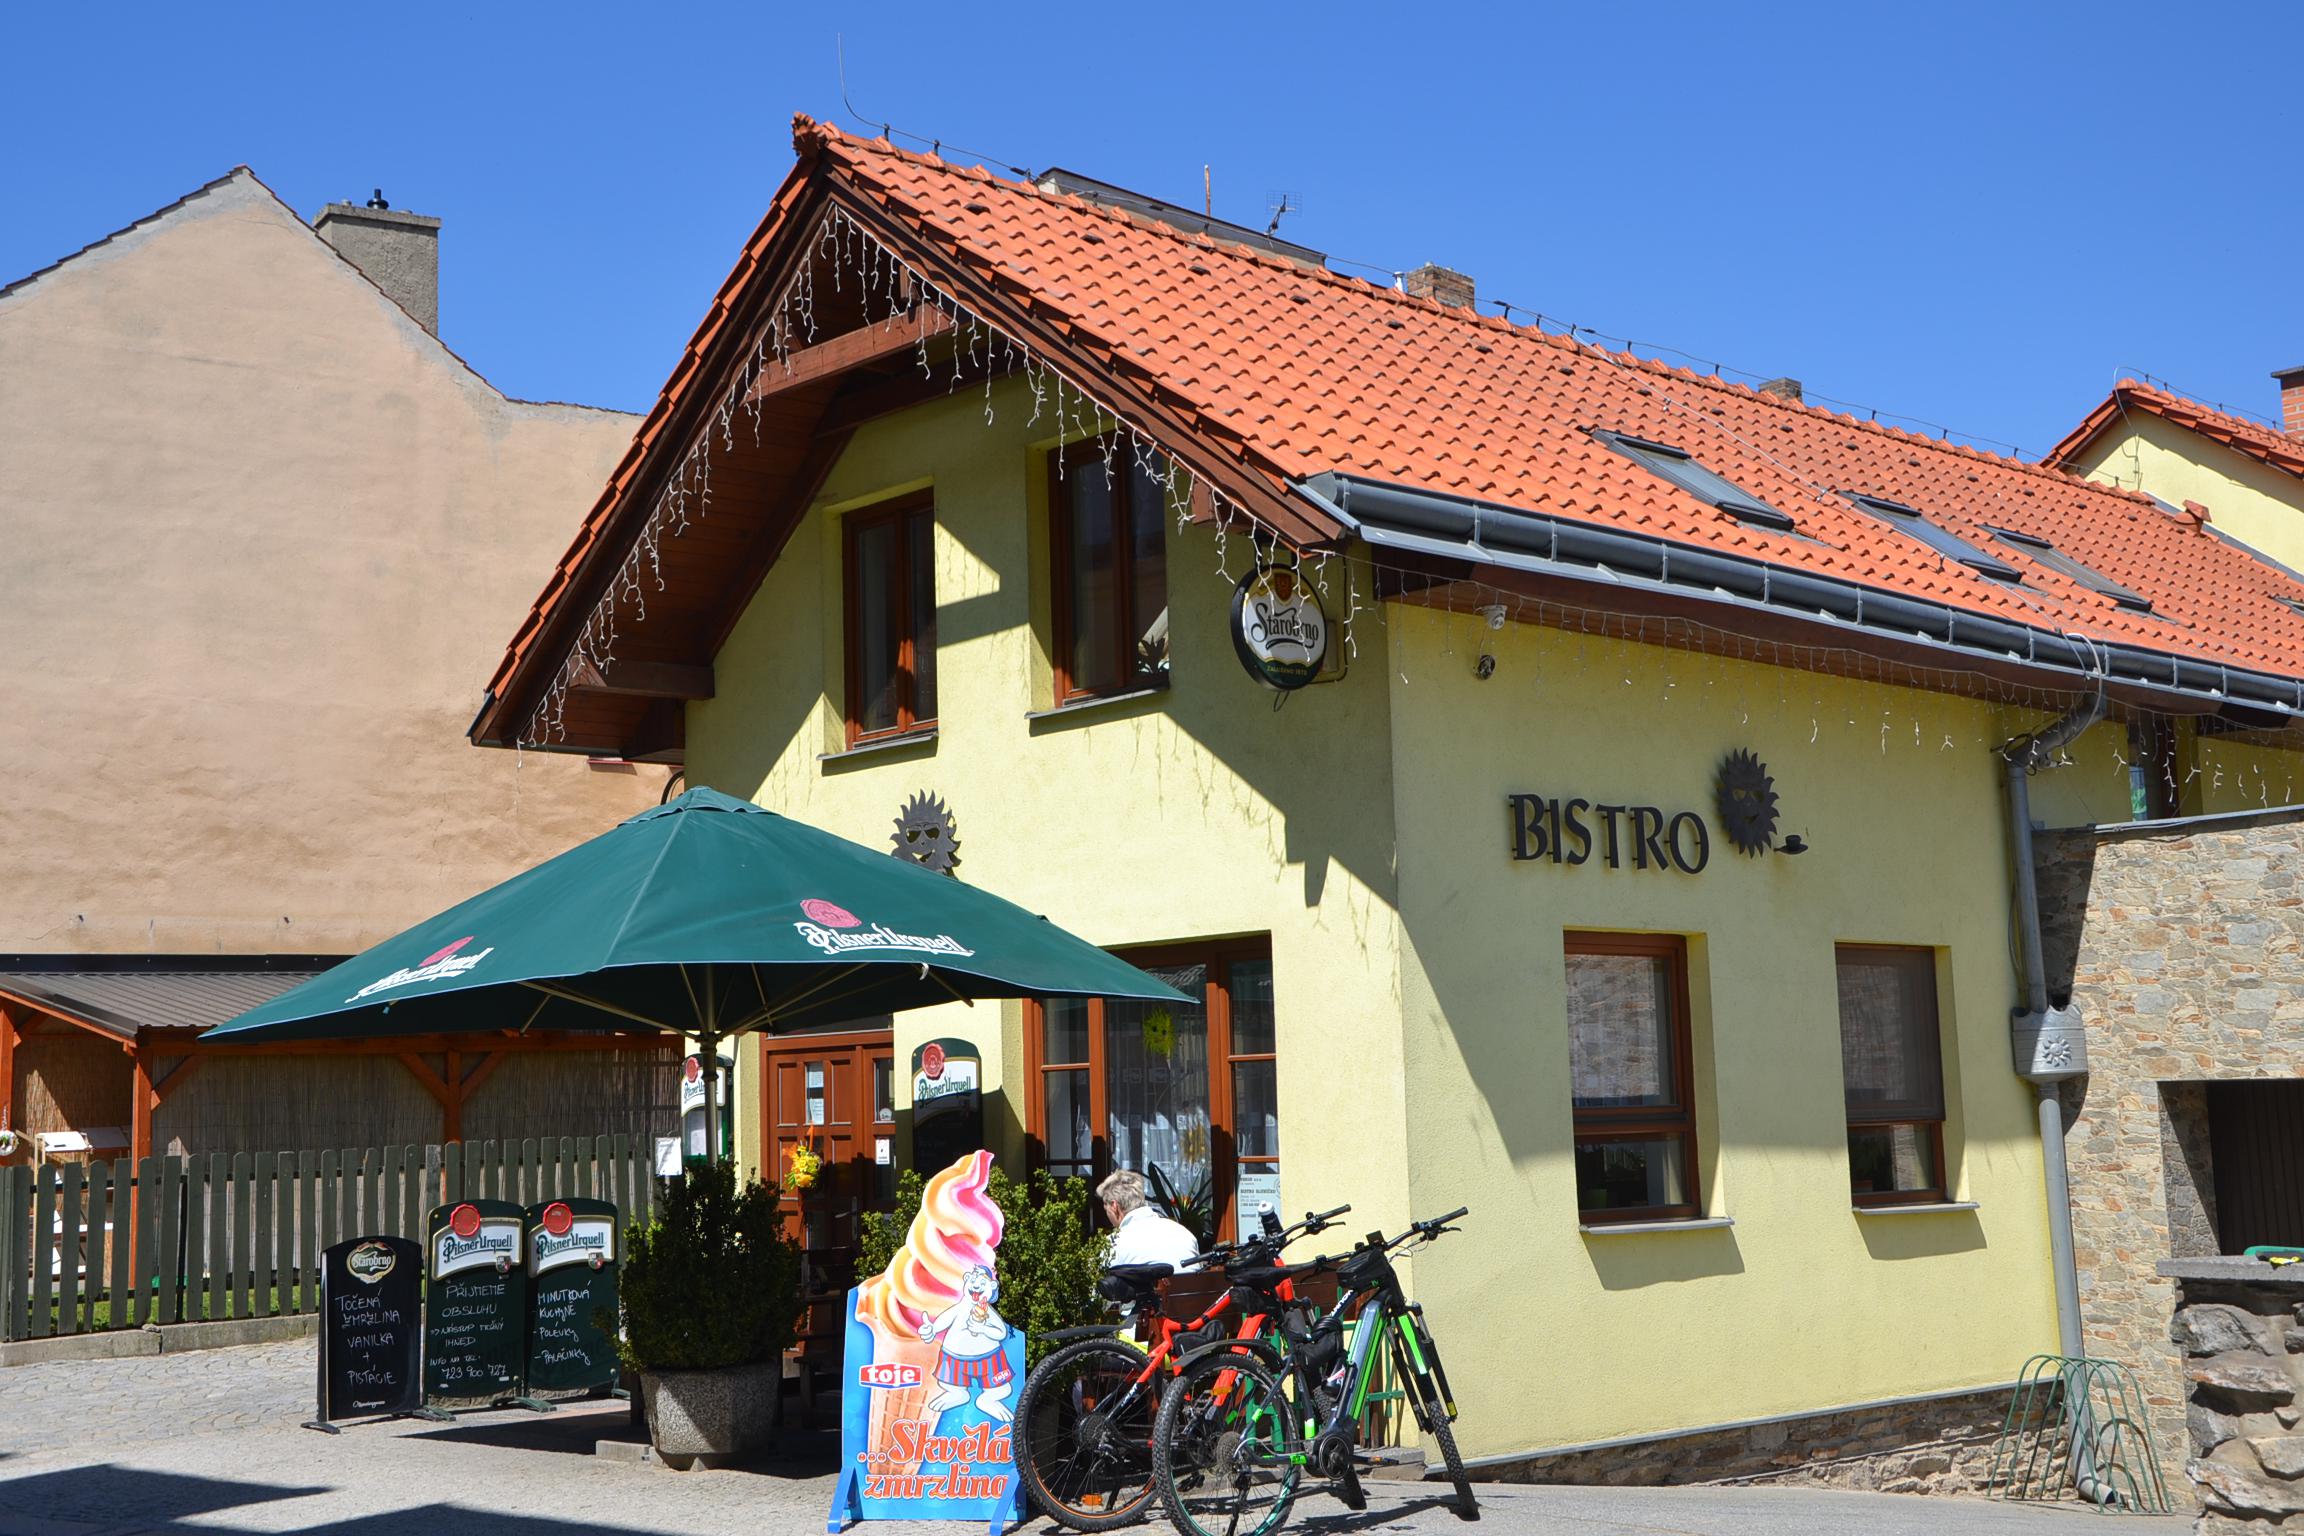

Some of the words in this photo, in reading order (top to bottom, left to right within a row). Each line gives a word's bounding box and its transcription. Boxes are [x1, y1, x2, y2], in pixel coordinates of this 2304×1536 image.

[1508, 793, 1710, 875] BISTRO
[793, 922, 884, 955] Pilsner
[871, 922, 976, 957] Urquell
[917, 1078, 946, 1109] Pilsner
[944, 1072, 972, 1098] Urquell
[443, 1236, 480, 1264] Pilsner
[478, 1233, 513, 1254] Urquell
[536, 1233, 572, 1260] Pilsner
[570, 1231, 605, 1250] Urquell
[335, 1287, 383, 1312] TOČENÁ
[441, 1303, 498, 1317] OBSLUHU
[342, 1309, 401, 1328] ZMRZLINA
[346, 1332, 395, 1348] VANILKA
[445, 1336, 476, 1348] IHNED
[346, 1364, 397, 1385] PISTÁCIE
[441, 1366, 463, 1380] 723
[466, 1365, 484, 1378] 900
[487, 1363, 507, 1376] 727
[868, 1364, 916, 1388] toje
[863, 1462, 1009, 1499] zmrzlina
